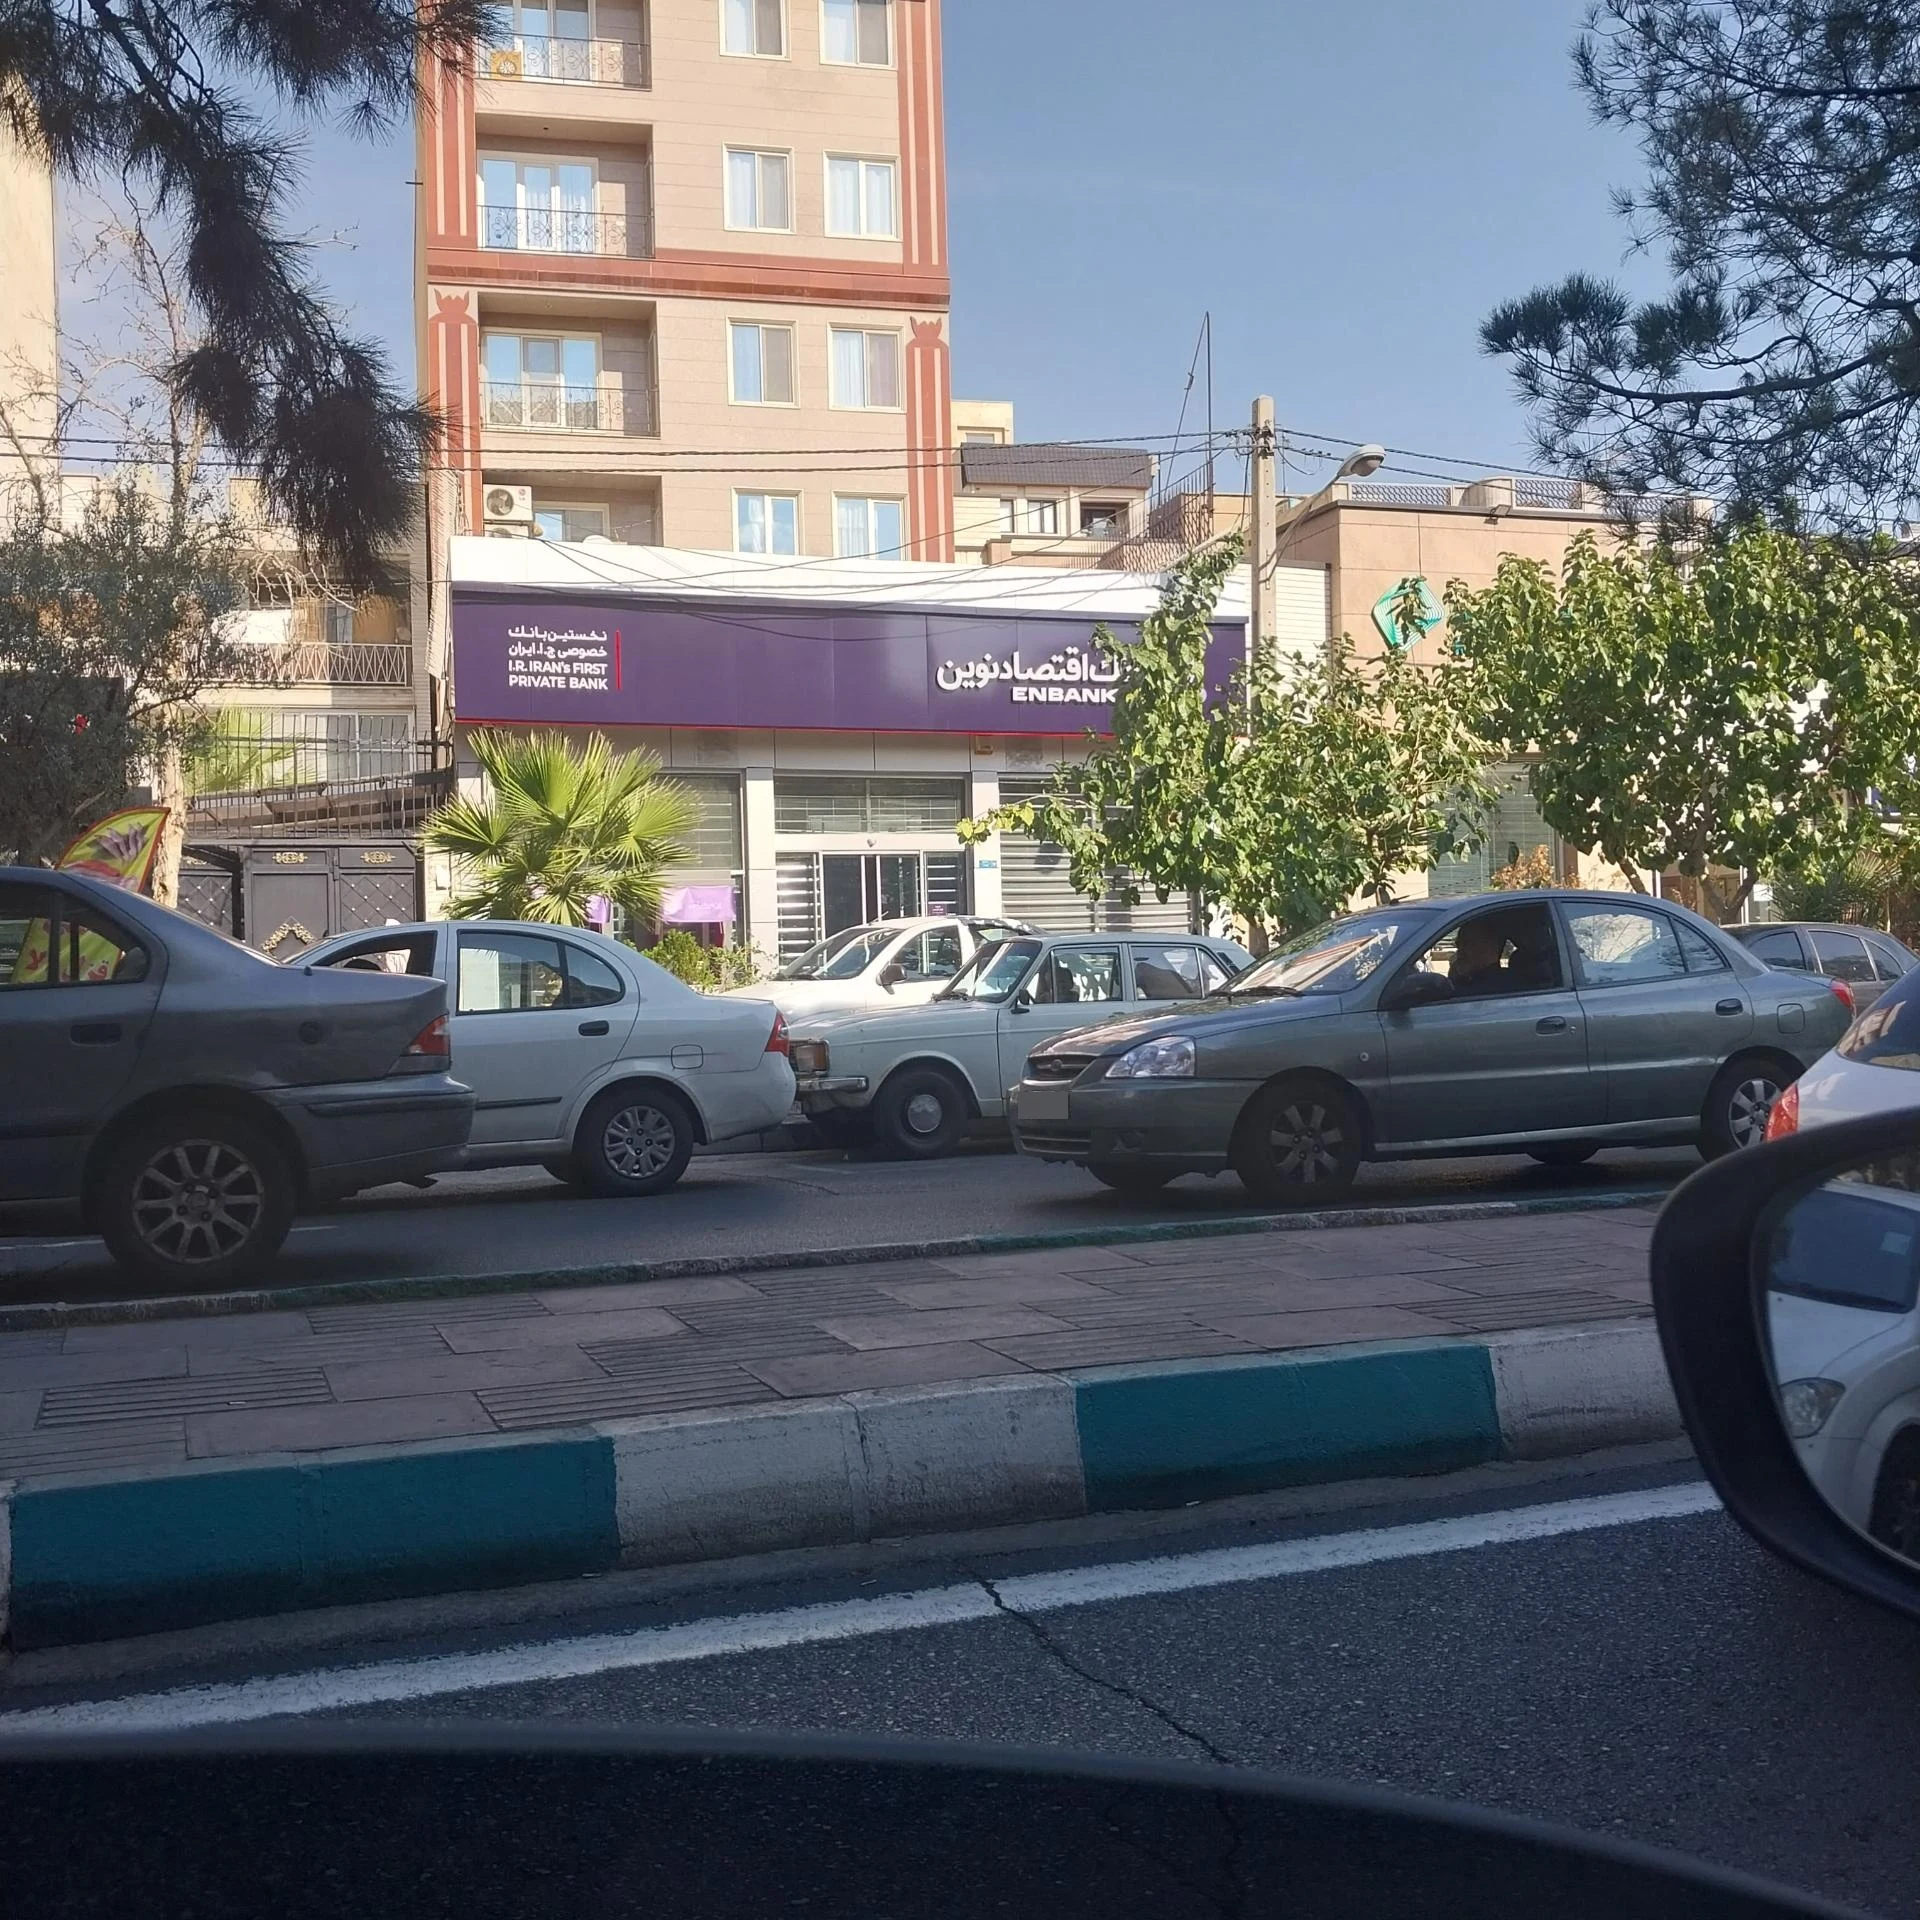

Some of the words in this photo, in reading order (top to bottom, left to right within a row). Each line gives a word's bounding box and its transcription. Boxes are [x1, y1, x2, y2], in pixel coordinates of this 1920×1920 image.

[508, 659, 528, 672] I.R.
[572, 662, 608, 675] FIRST
[508, 674, 566, 688] PRIVATE
[569, 677, 608, 690] BANK
[1012, 686, 1119, 703] ENBANK
